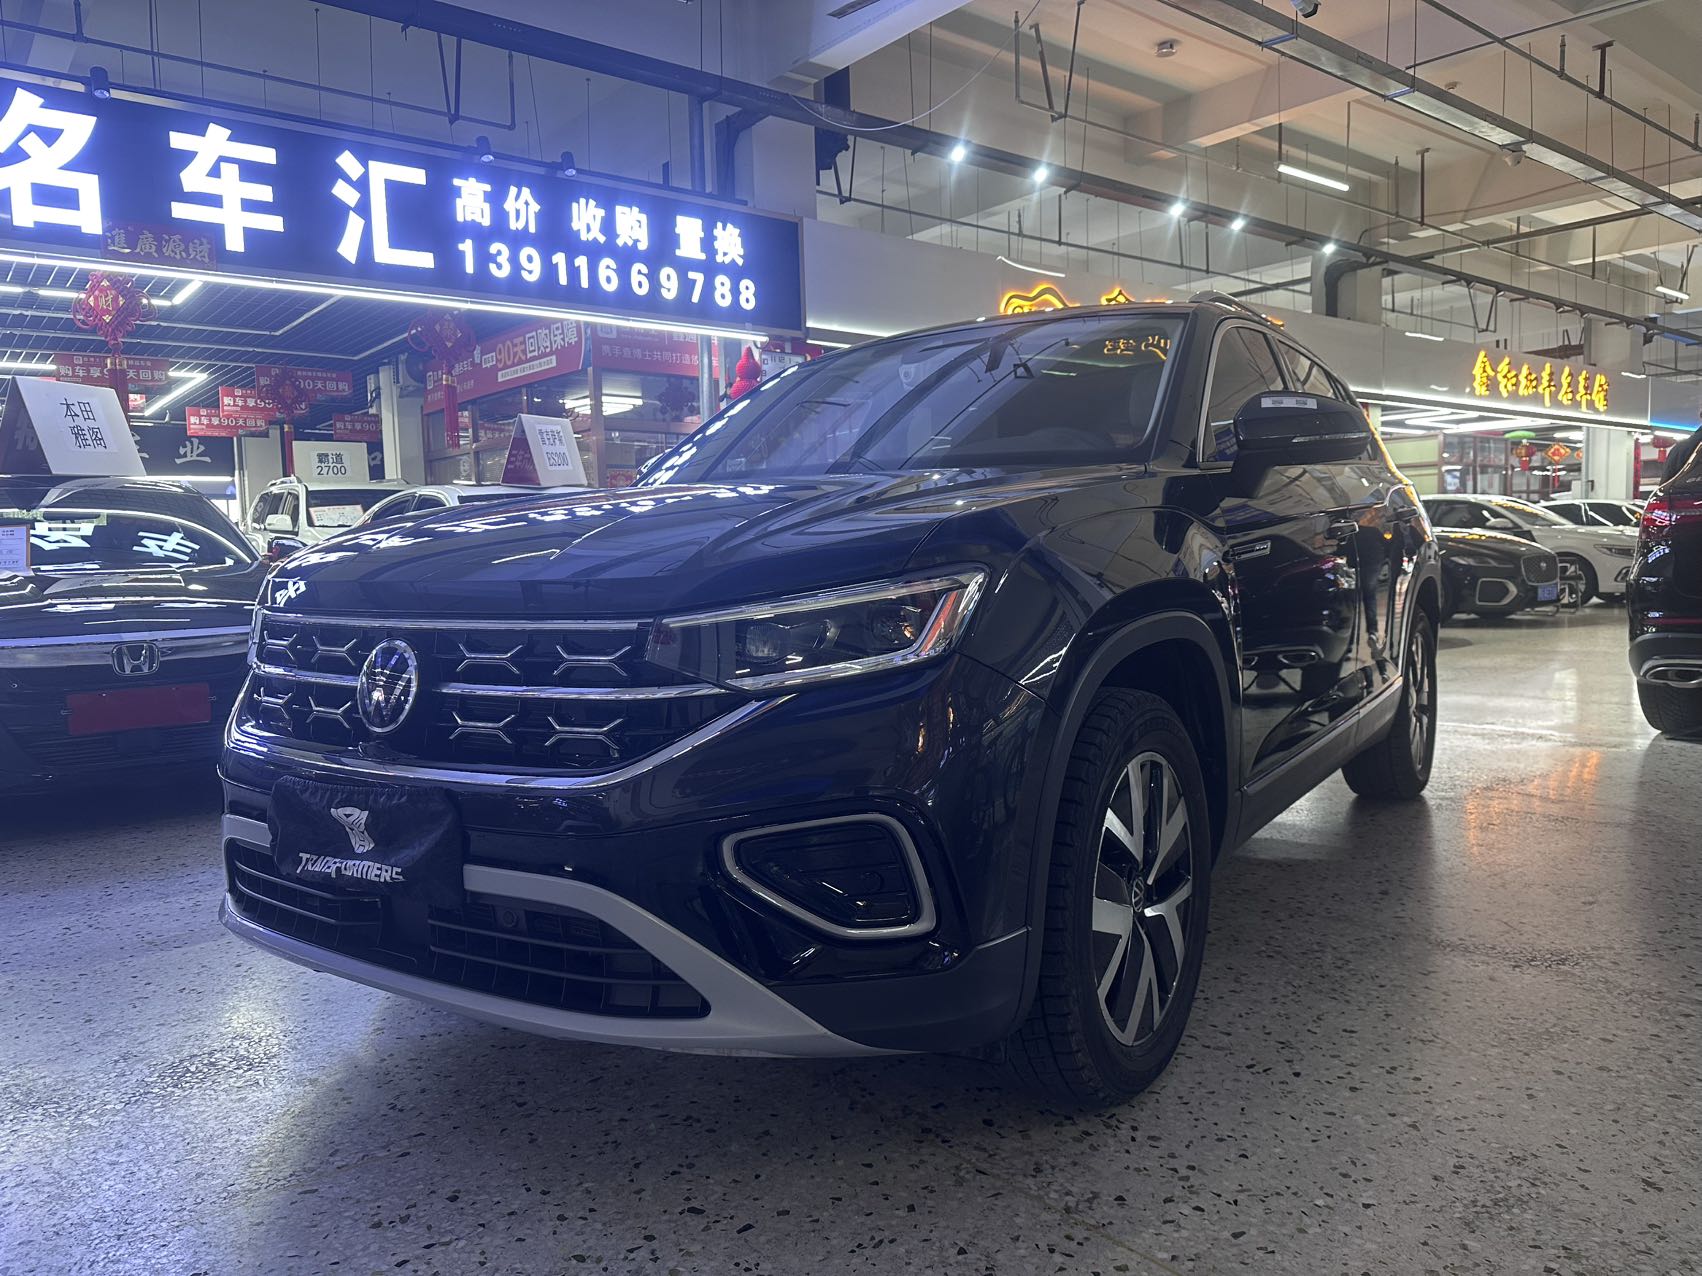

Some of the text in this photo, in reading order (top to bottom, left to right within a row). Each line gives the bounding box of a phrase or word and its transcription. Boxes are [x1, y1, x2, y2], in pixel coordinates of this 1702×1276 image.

[0, 87, 436, 270] 名车汇
[452, 177, 745, 267] 高价 收购 置换
[457, 238, 757, 312] 13911669788
[59, 397, 96, 424] 本田
[189, 415, 266, 428] 购车享90天回购
[69, 425, 108, 450] 雅阁
[315, 464, 347, 476] 2700
[316, 452, 345, 465] 霸道
[296, 852, 407, 883] TRANSFORMERS
